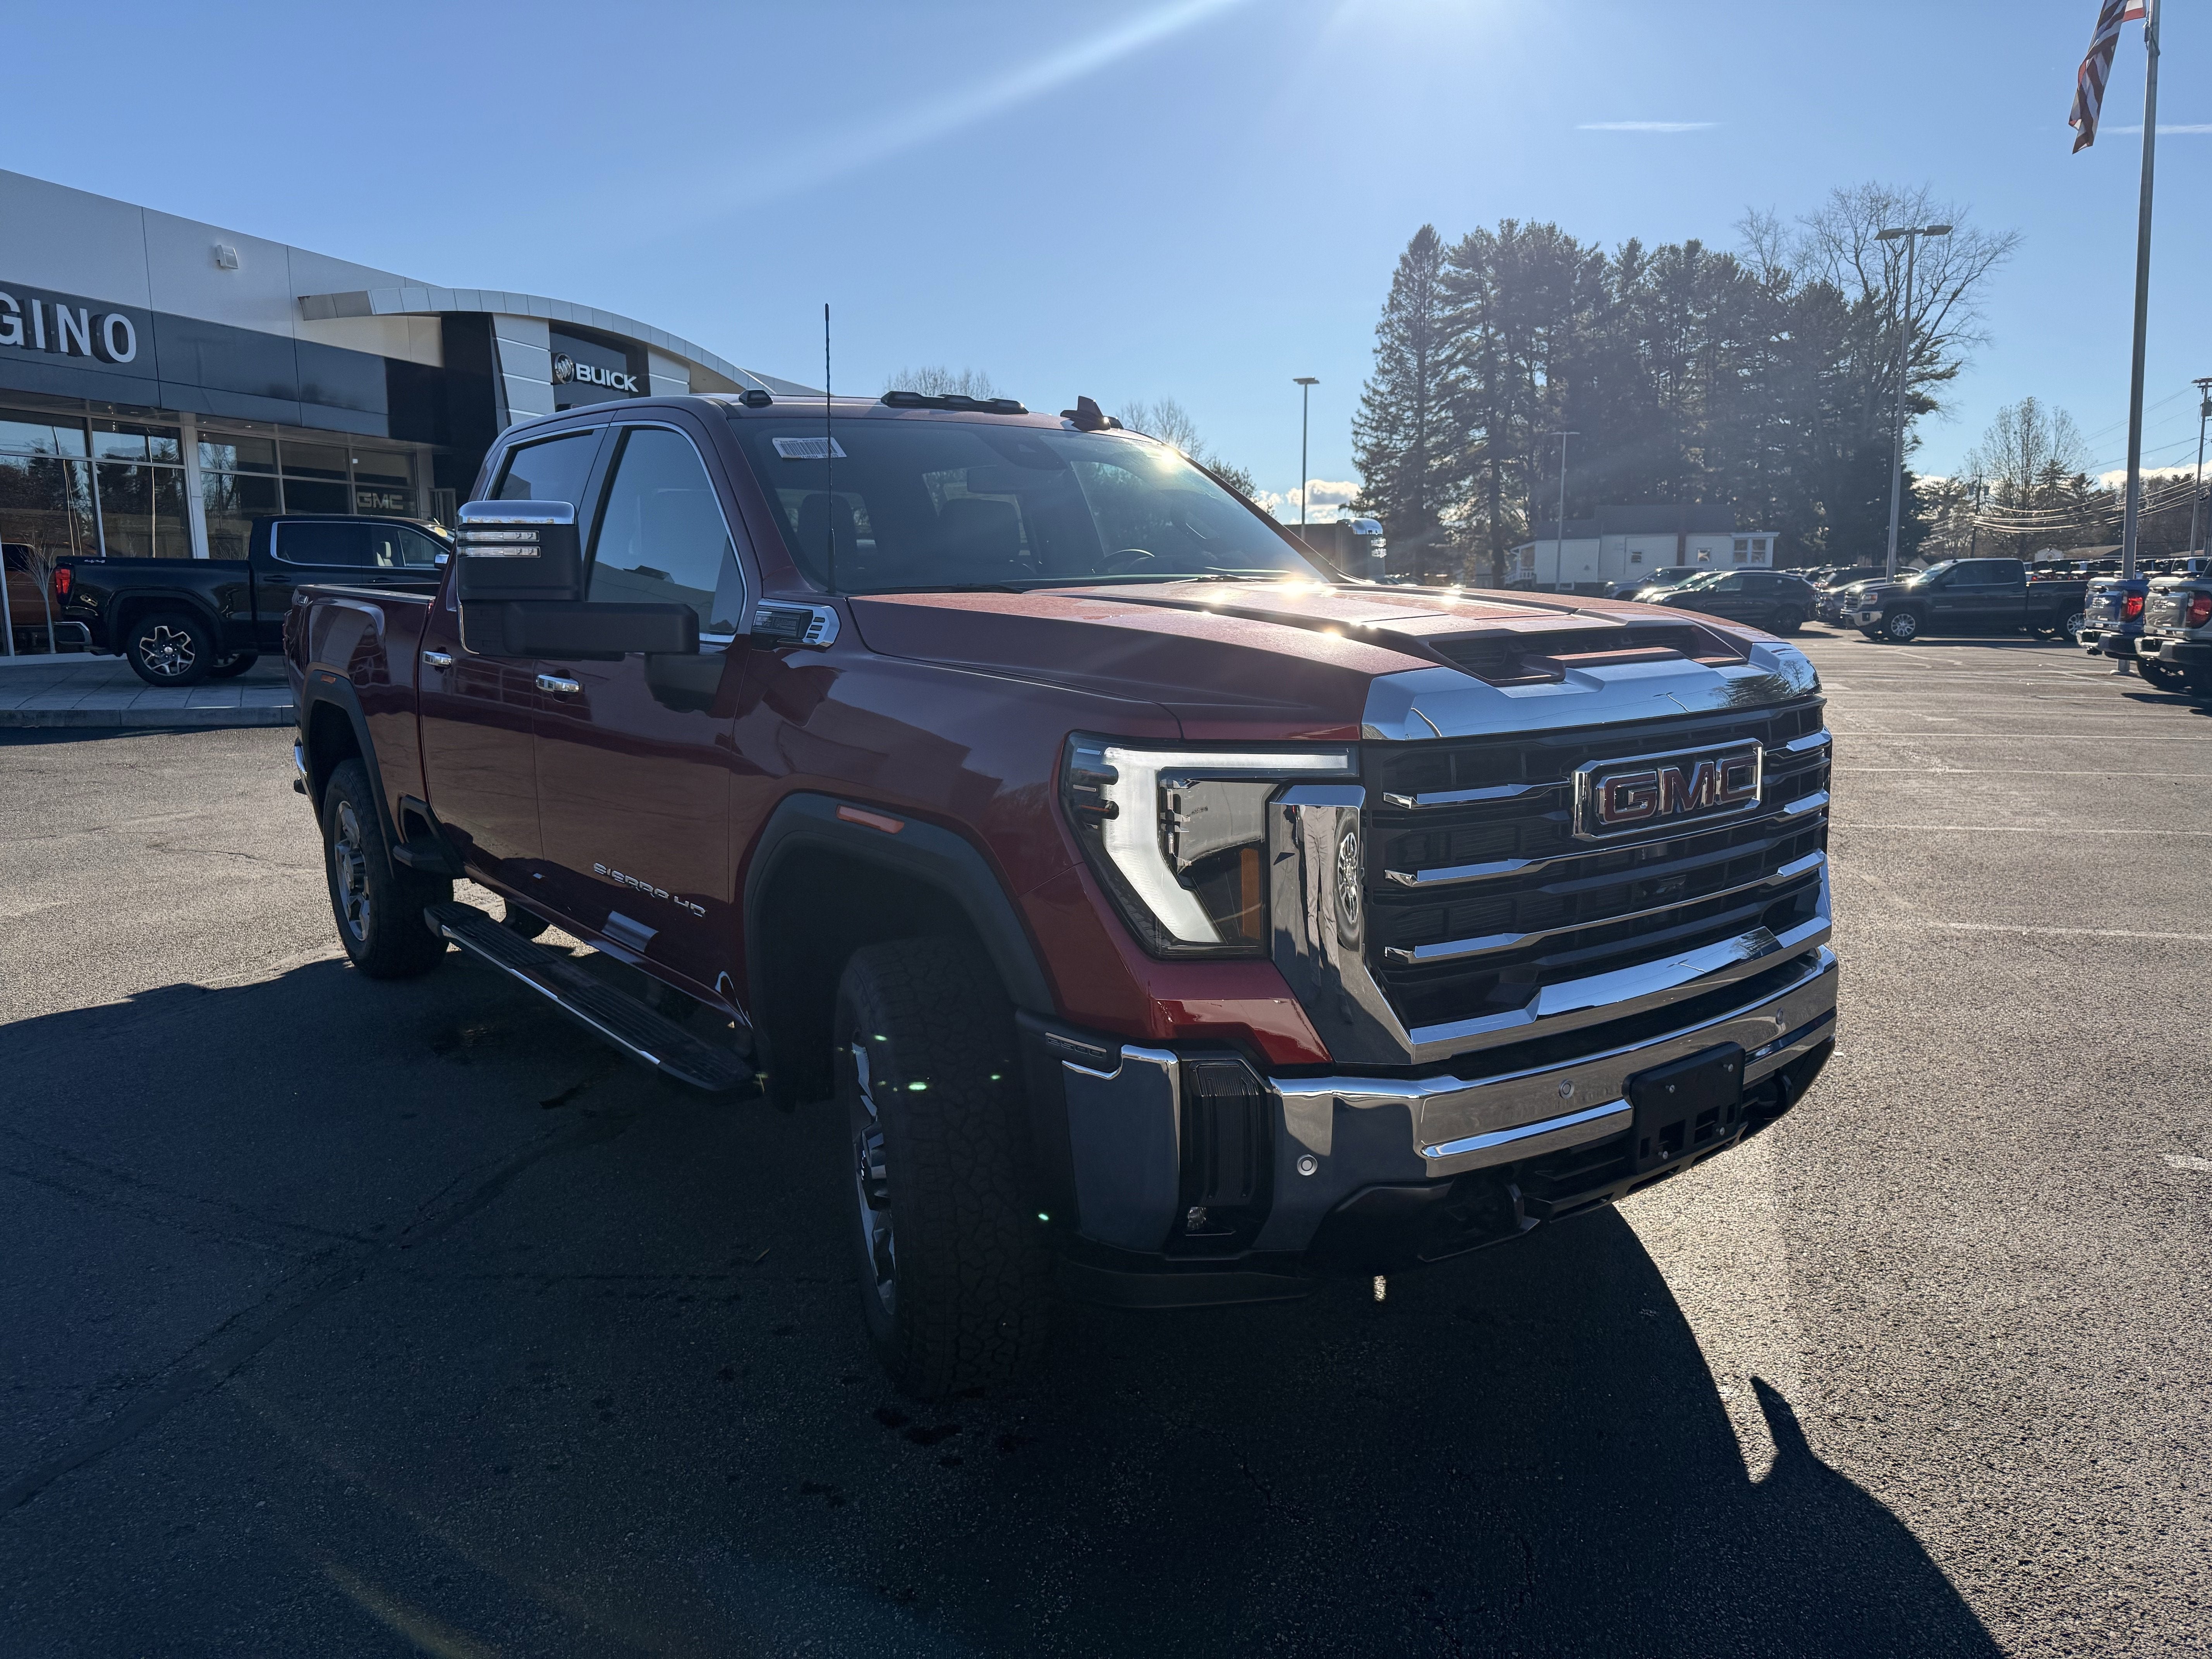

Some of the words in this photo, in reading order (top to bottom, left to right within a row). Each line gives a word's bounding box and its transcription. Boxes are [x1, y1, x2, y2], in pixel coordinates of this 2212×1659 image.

[0, 292, 136, 362] GINO
[575, 363, 639, 392] BUICK
[356, 491, 404, 510] GMC
[1596, 754, 1758, 825] GMC
[593, 862, 669, 900] SIERRA
[1047, 1037, 1104, 1058] 2500
